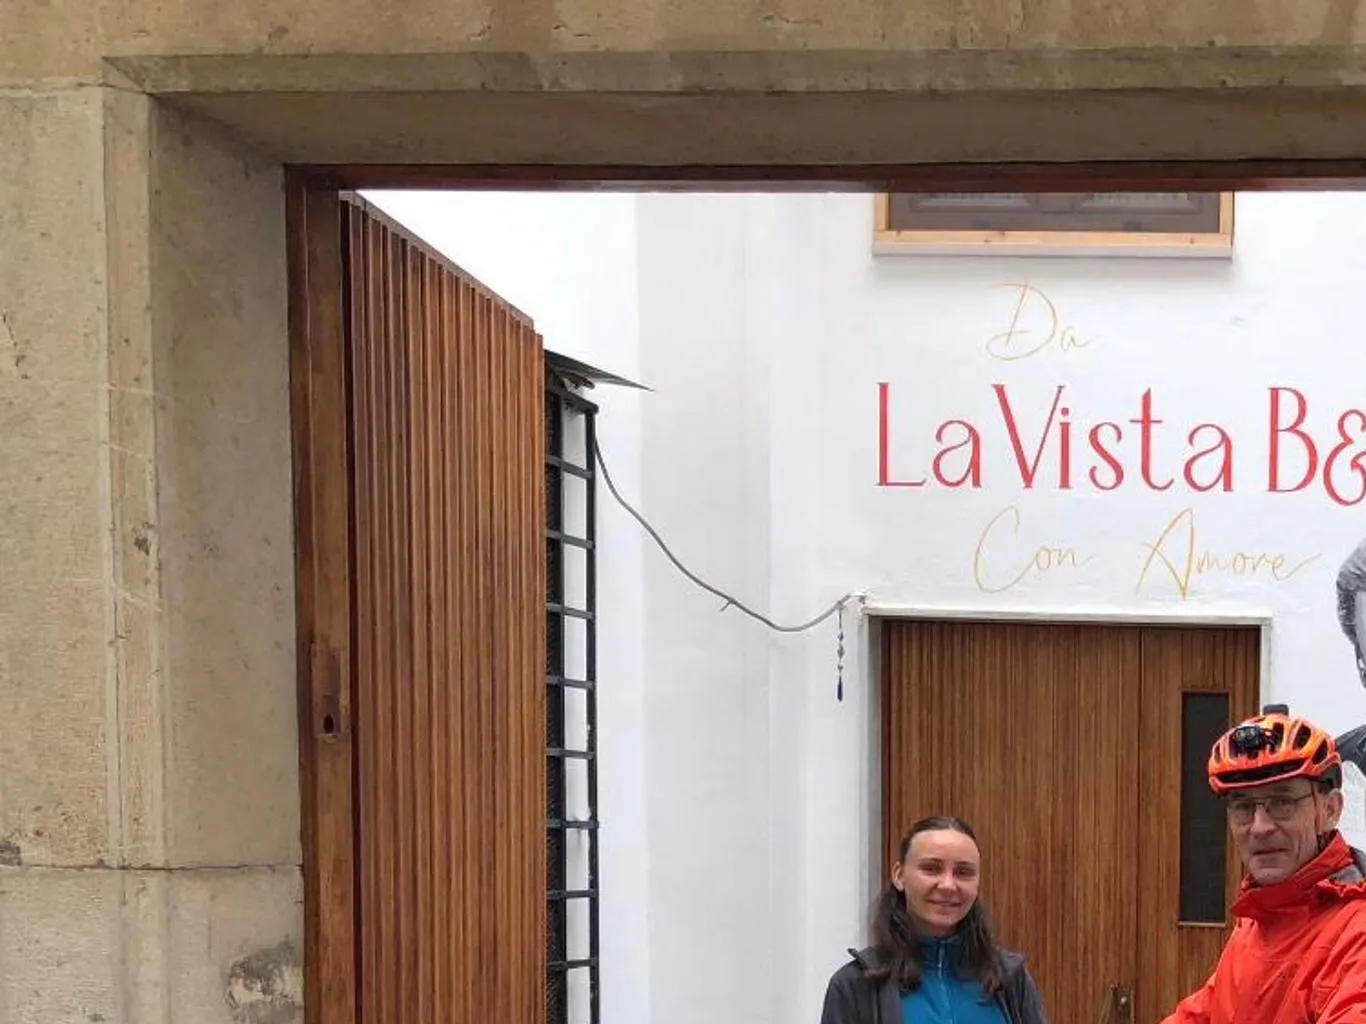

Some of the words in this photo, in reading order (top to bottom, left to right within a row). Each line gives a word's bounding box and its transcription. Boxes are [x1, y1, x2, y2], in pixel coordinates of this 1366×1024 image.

[985, 281, 1095, 361] Da
[972, 506, 1096, 594] Con
[1136, 507, 1322, 601] Amore
